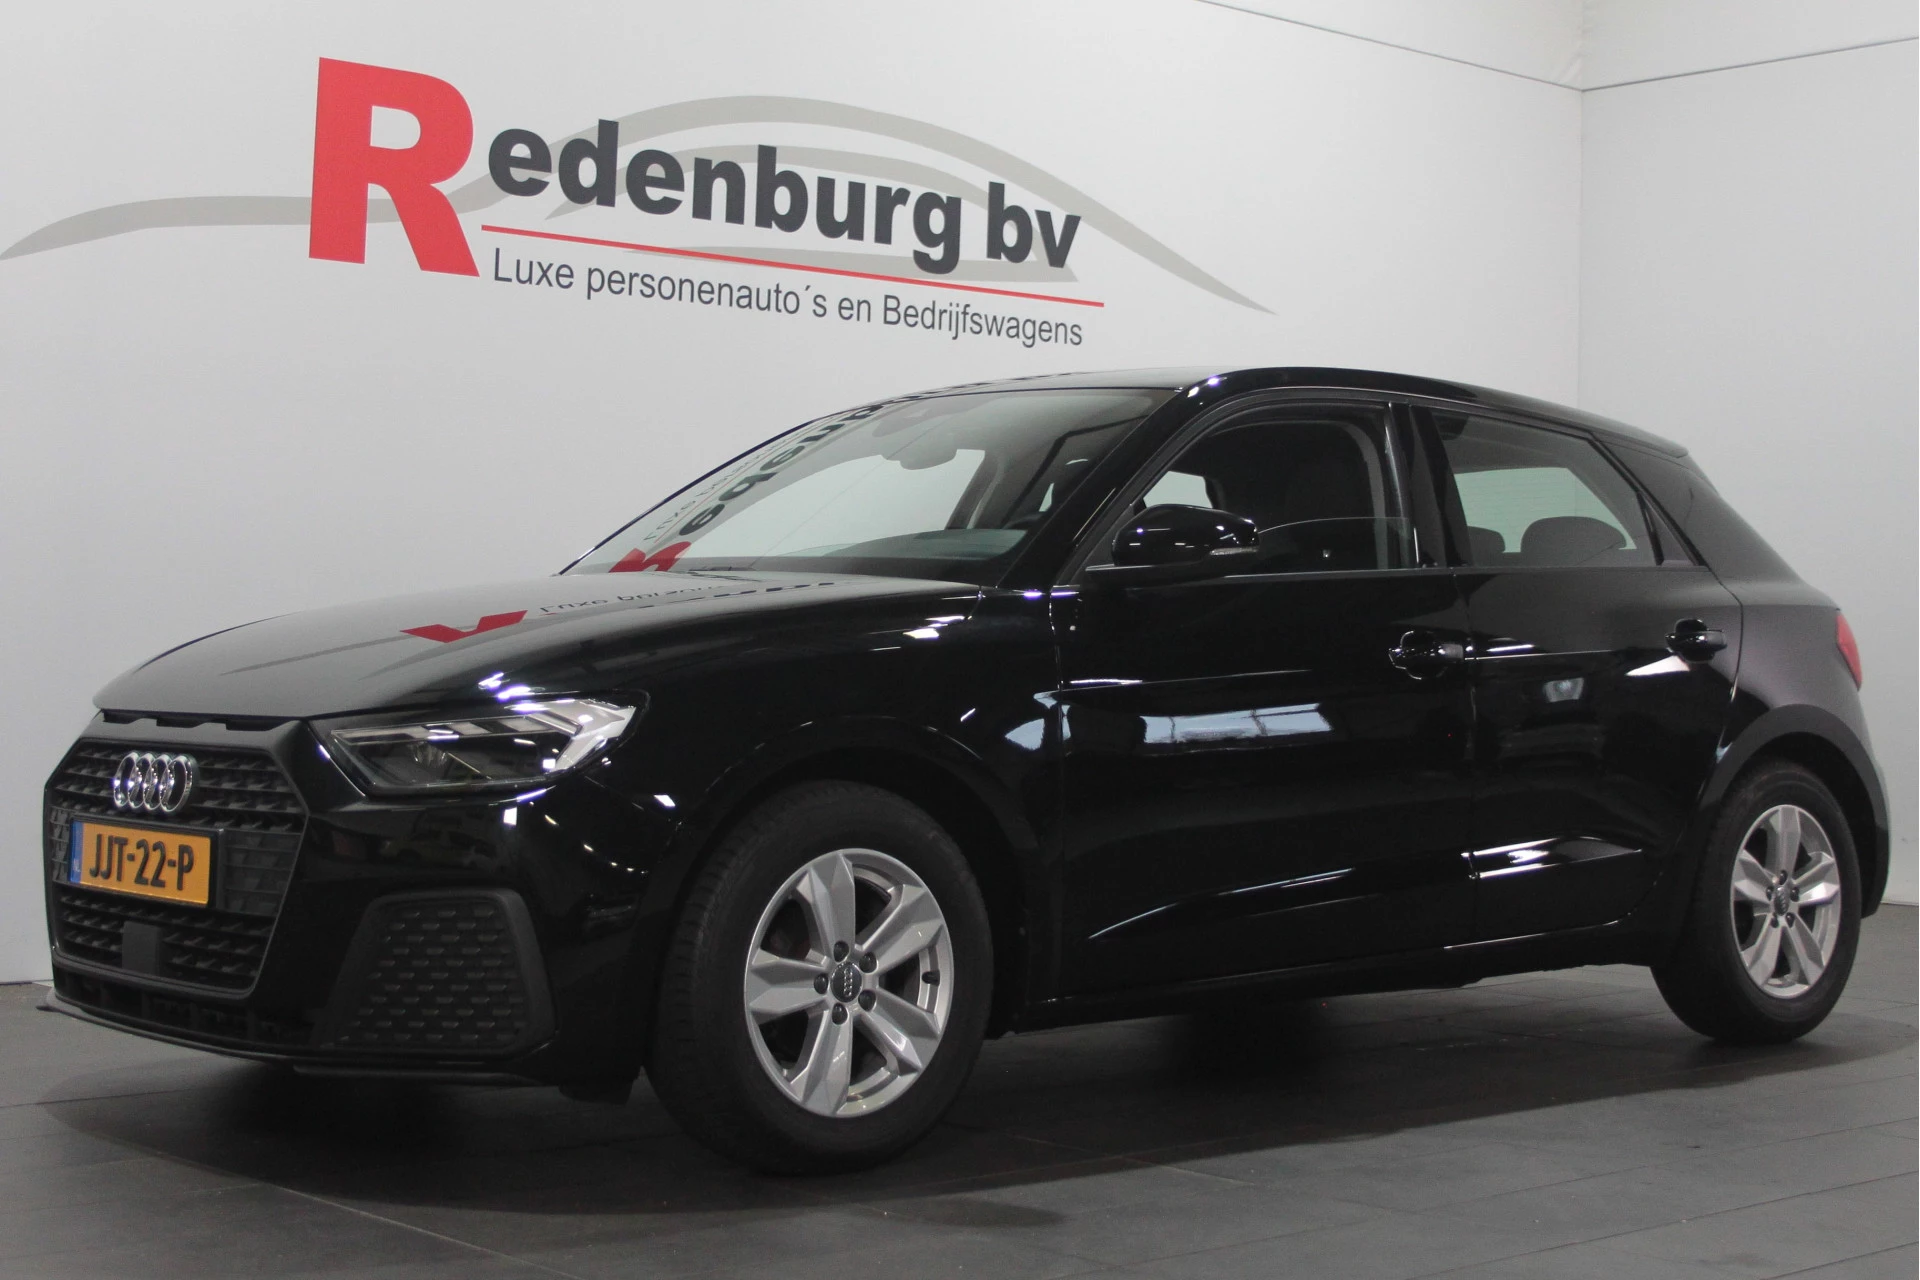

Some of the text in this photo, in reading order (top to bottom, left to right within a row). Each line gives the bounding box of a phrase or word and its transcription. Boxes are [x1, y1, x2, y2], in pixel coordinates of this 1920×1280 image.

[309, 57, 1081, 276] Redenburg bv
[493, 247, 574, 289] Luxe
[838, 297, 872, 323] en
[883, 294, 1083, 348] Bedrijfswagens
[89, 833, 195, 891] JJT-22-P
